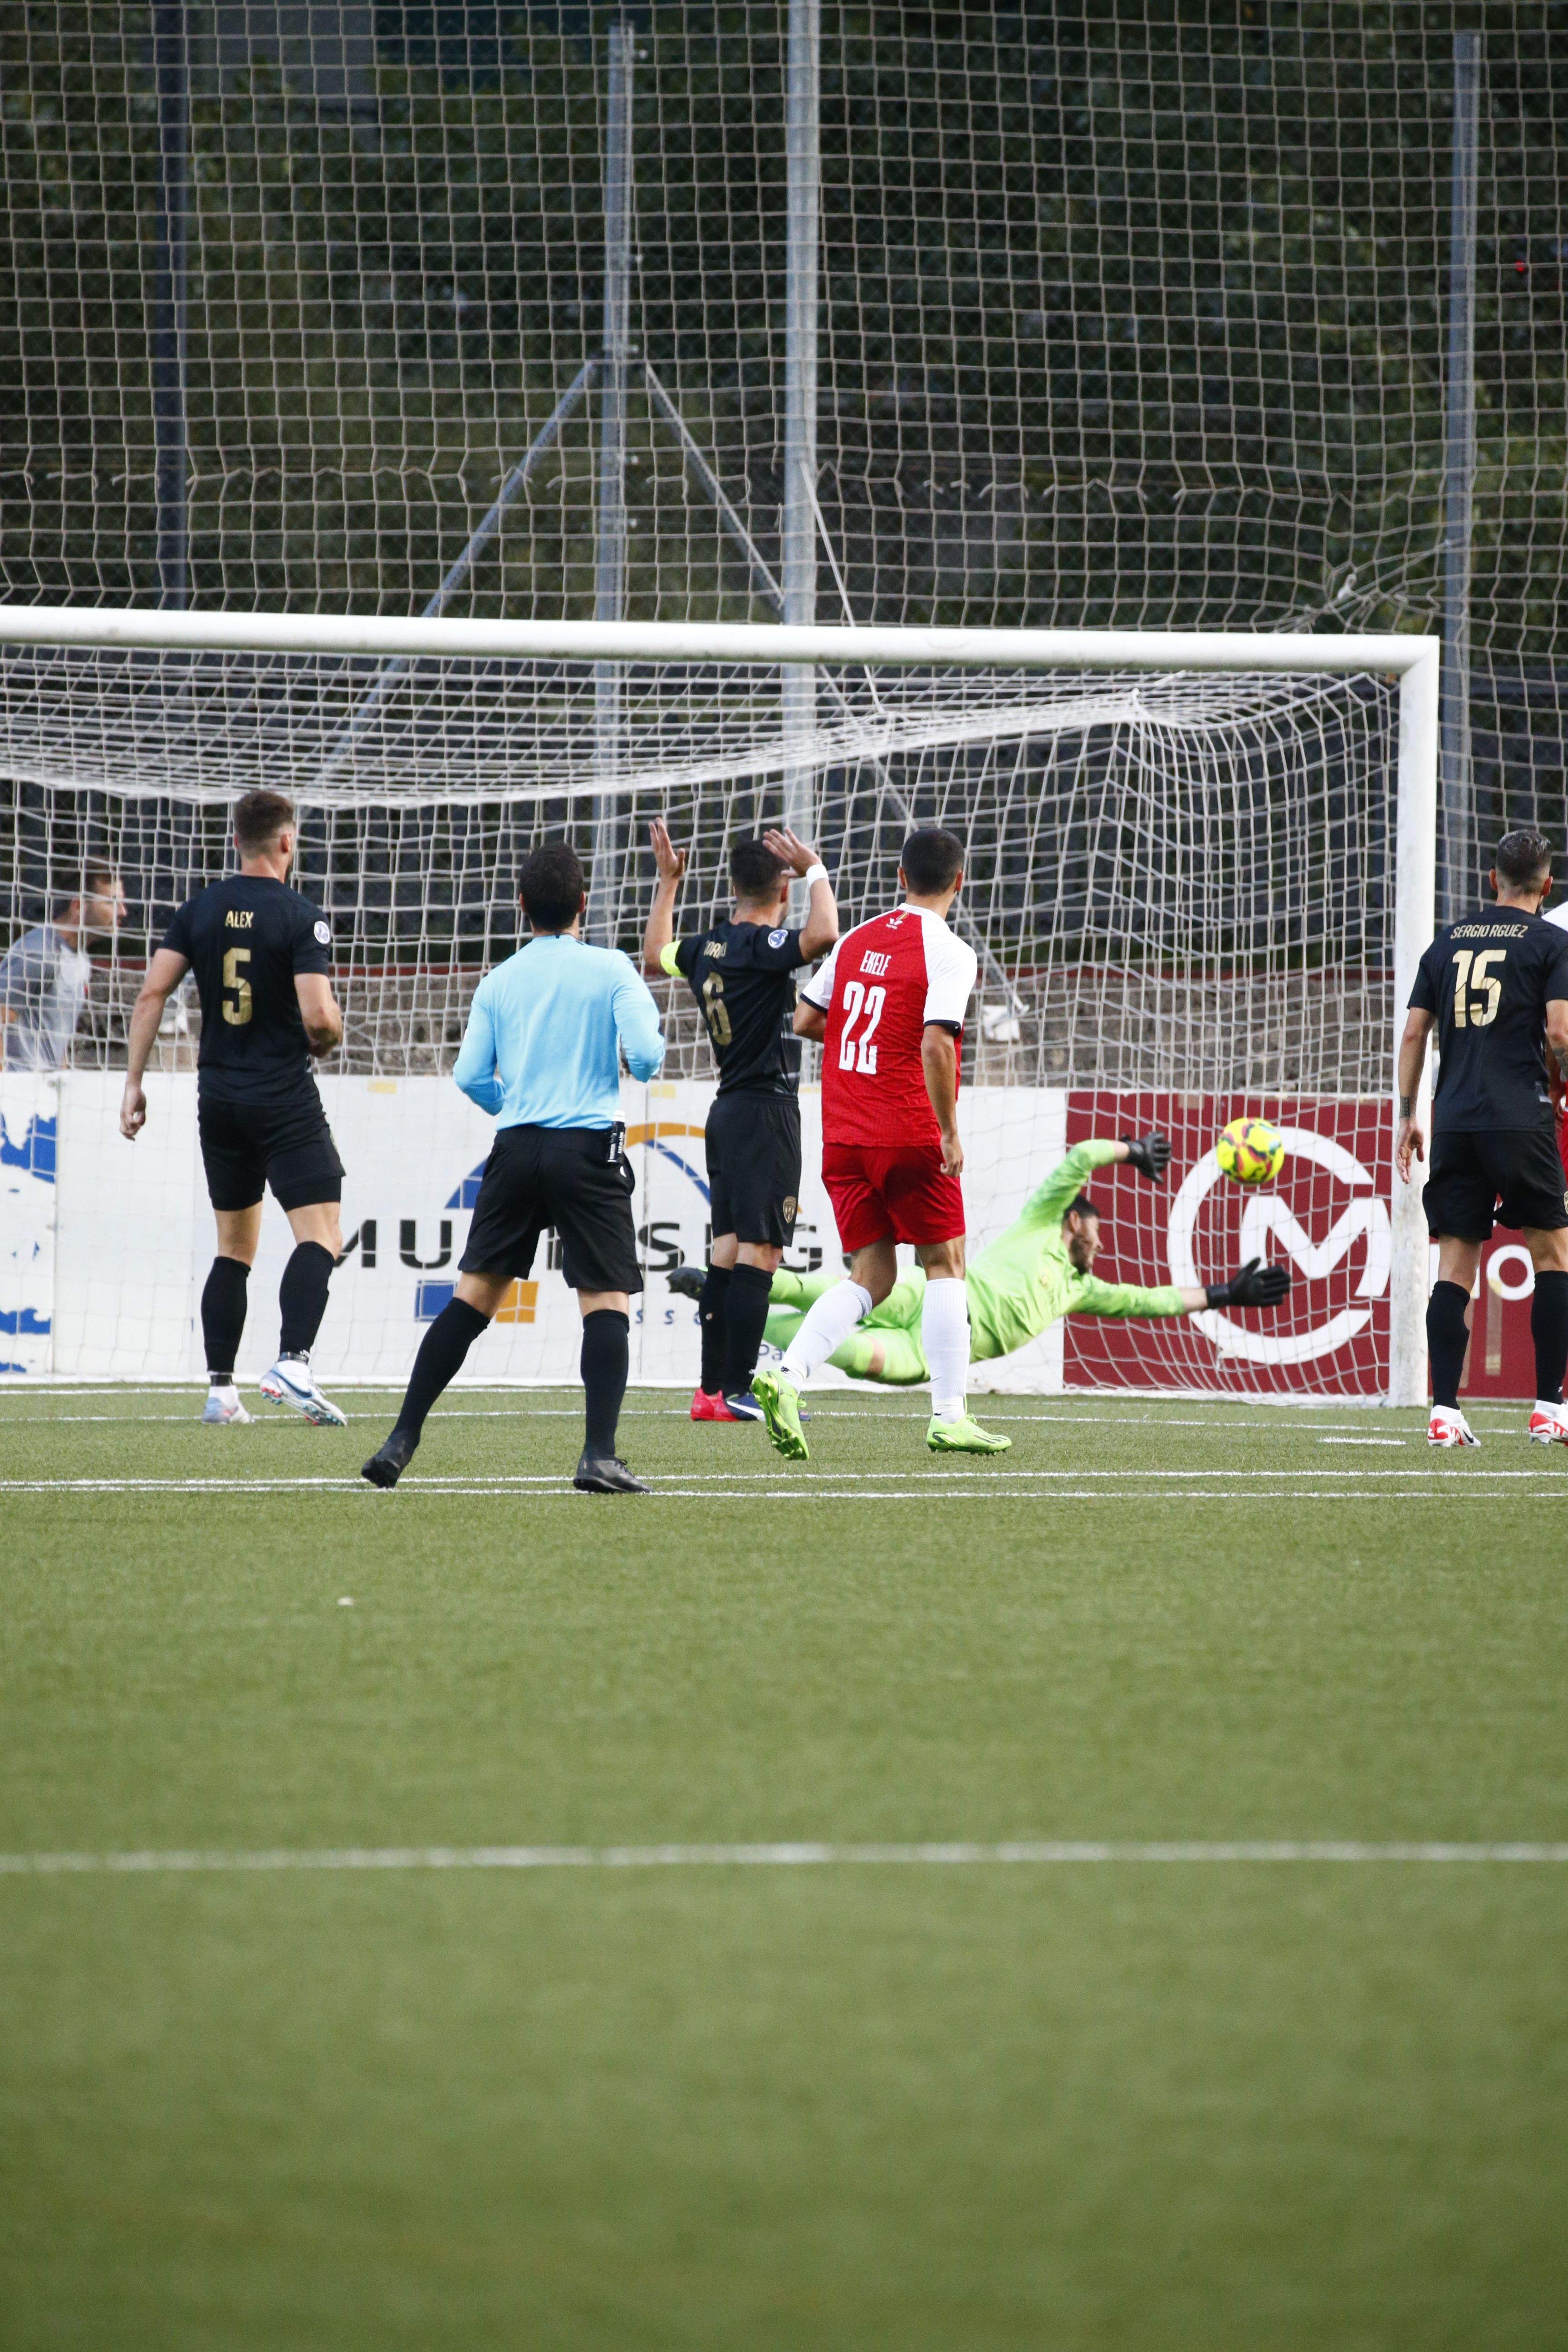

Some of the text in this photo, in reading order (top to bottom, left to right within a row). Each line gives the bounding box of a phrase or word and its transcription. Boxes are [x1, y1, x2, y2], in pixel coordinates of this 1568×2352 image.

[225, 910, 254, 929] ALEX
[1450, 924, 1529, 939] SERGIO RGUEZ
[222, 947, 253, 1025] 5
[859, 950, 892, 976] EKELE
[1452, 949, 1507, 1028] 15
[702, 971, 732, 1045] 6
[838, 981, 887, 1075] 22
